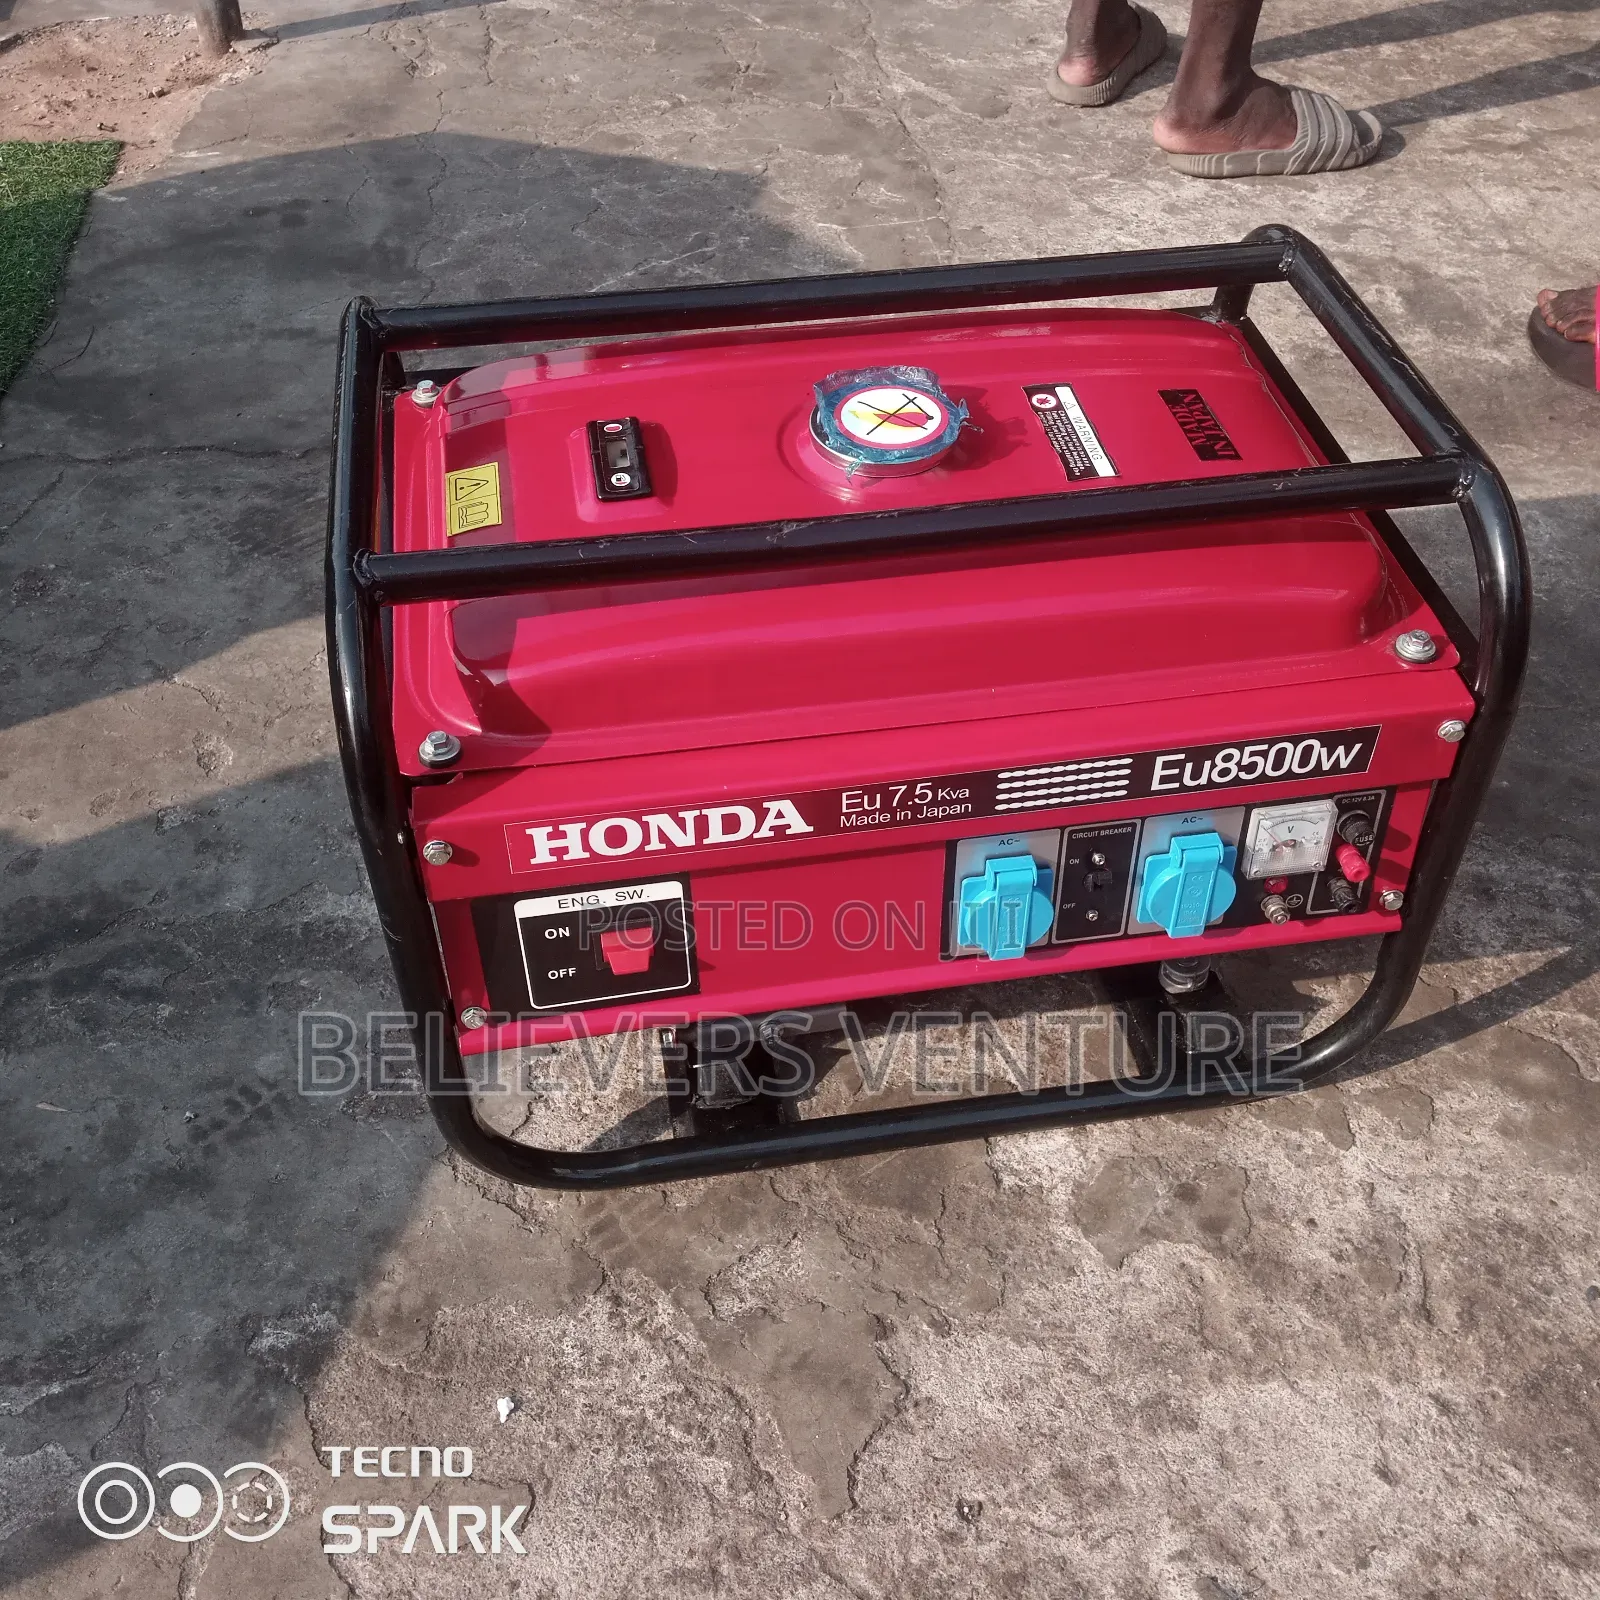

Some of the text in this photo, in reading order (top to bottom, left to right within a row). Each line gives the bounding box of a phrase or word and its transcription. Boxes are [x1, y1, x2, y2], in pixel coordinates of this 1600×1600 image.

[1168, 404, 1210, 446] MADE
[1181, 394, 1235, 455] IN JAPAN
[1072, 415, 1103, 462] WARNING
[1150, 738, 1363, 791] Eu8500w
[841, 781, 971, 814] Eu 7.5 Kva
[839, 803, 972, 829] Made in Japan
[525, 799, 814, 865] HONDA
[1071, 826, 1133, 840] CIRCUIT BREAKER
[1287, 825, 1295, 834] V
[1355, 834, 1374, 844] FUSE
[557, 888, 651, 910] ENG. SW.
[1062, 902, 1076, 910] OFF
[544, 926, 571, 941] ON
[547, 967, 578, 981] OFF
